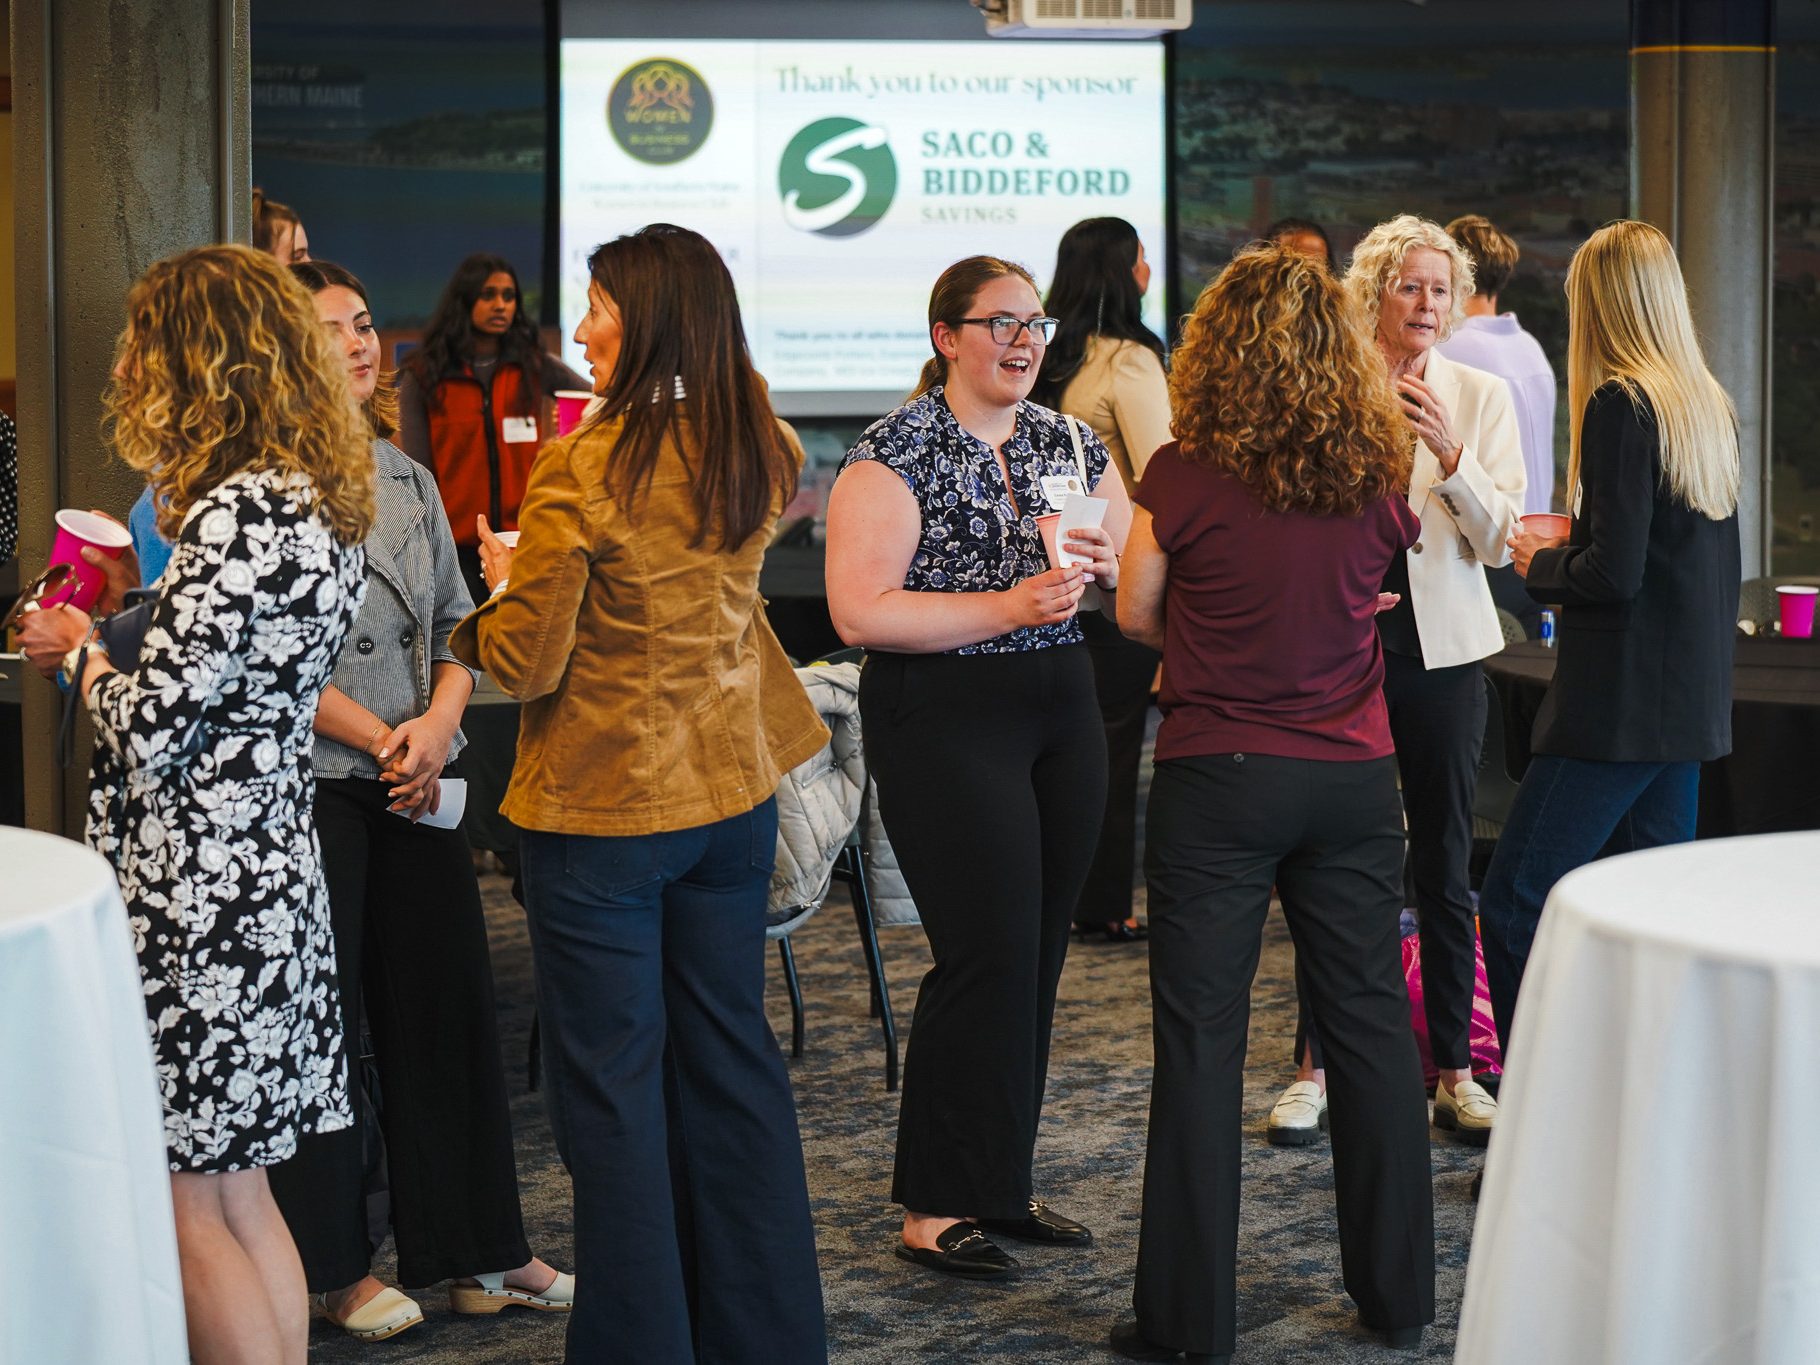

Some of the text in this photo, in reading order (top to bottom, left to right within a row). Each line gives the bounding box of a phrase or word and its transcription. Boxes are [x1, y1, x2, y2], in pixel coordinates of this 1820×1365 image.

[254, 84, 301, 106] HERN
[775, 66, 1138, 102] Thank you to our sponsor
[625, 109, 692, 124] WOMEN
[921, 131, 1051, 159] SACO &
[921, 168, 1131, 196] BIDDEFORD
[921, 207, 1017, 224] SAVINGS
